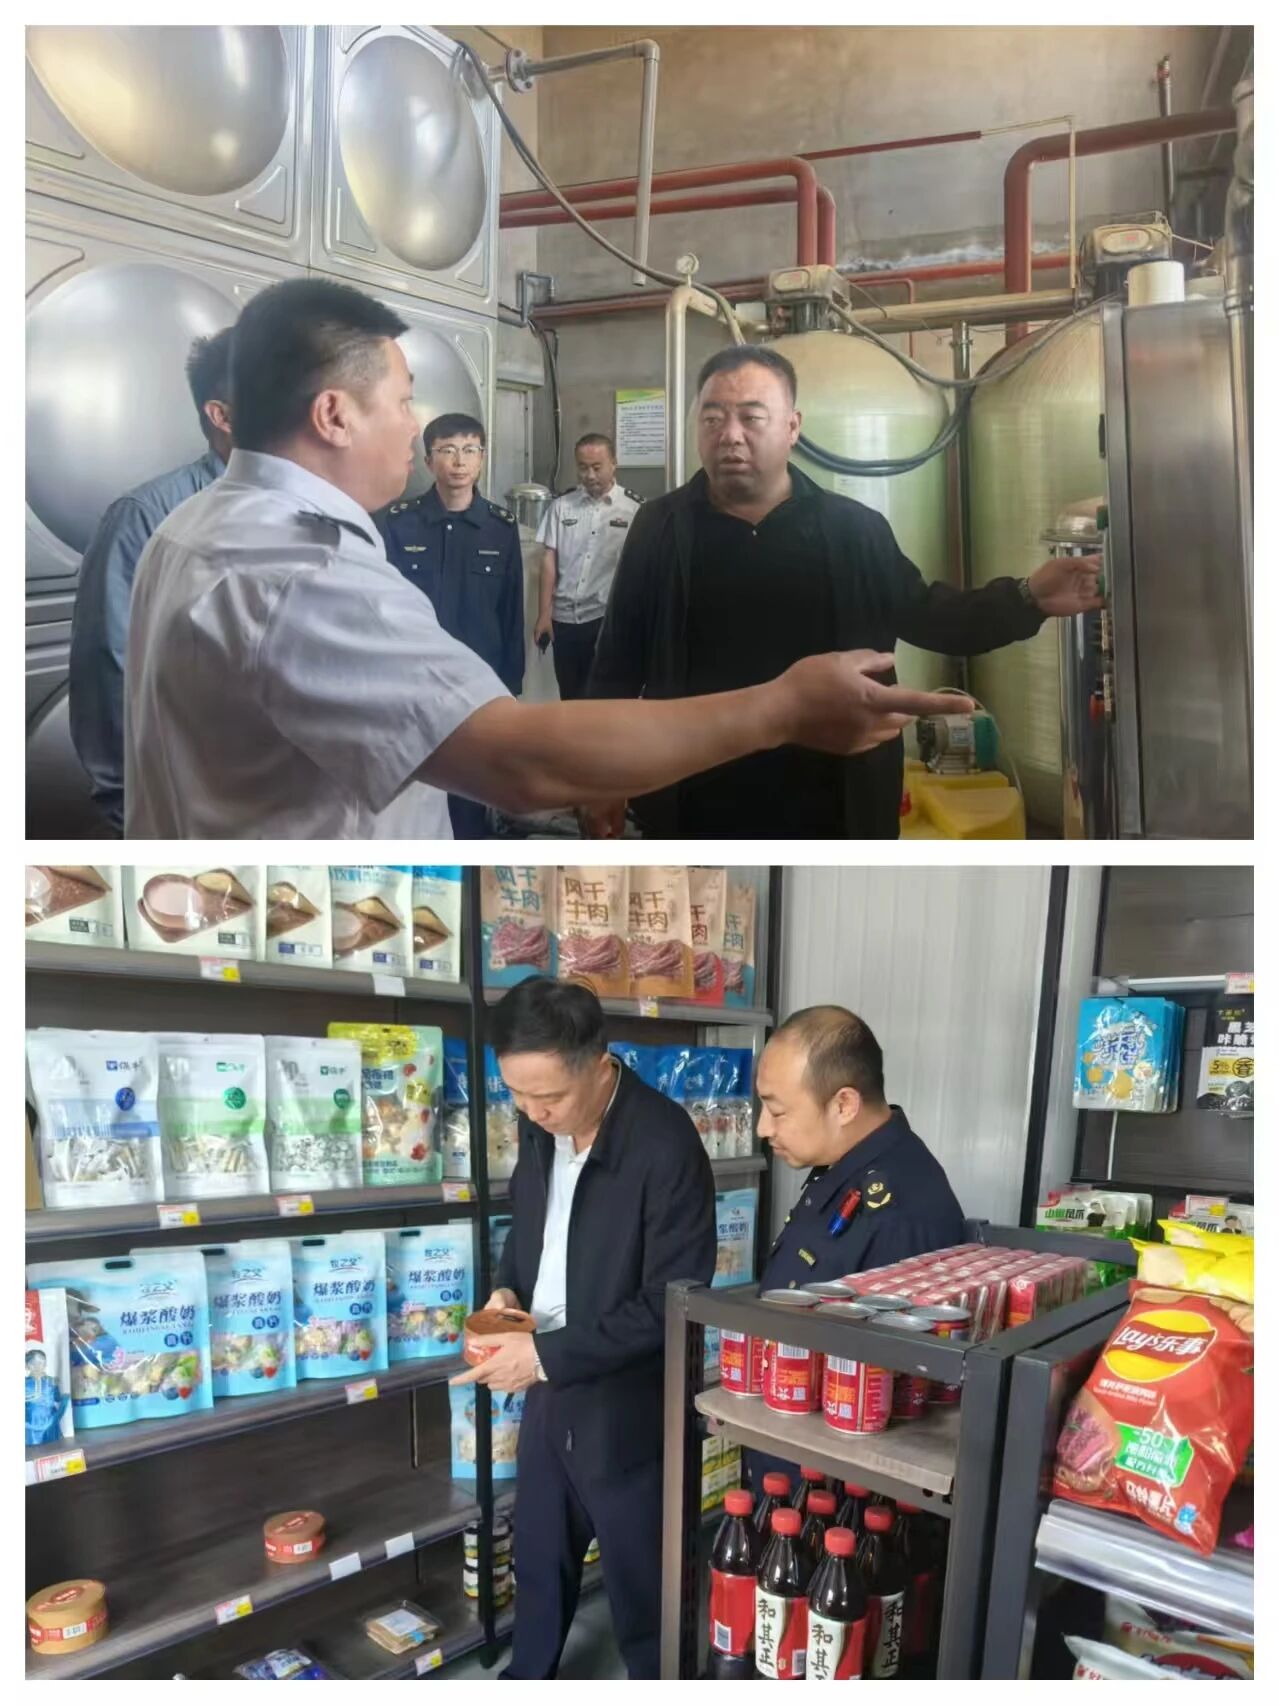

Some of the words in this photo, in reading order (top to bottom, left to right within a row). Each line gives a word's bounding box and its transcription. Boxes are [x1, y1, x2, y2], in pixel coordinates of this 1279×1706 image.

[501, 886, 541, 911] 牛肉
[565, 877, 605, 901] 风干
[566, 900, 608, 921] 牛肉
[629, 910, 668, 930] 牛肉
[408, 1266, 465, 1283] 爆浆酸奶
[314, 1279, 375, 1296] 爆浆酸奶
[213, 1290, 281, 1308] 爆浆酸奶
[120, 1304, 195, 1326] 爆浆酸奶
[757, 1598, 777, 1668] 和其正
